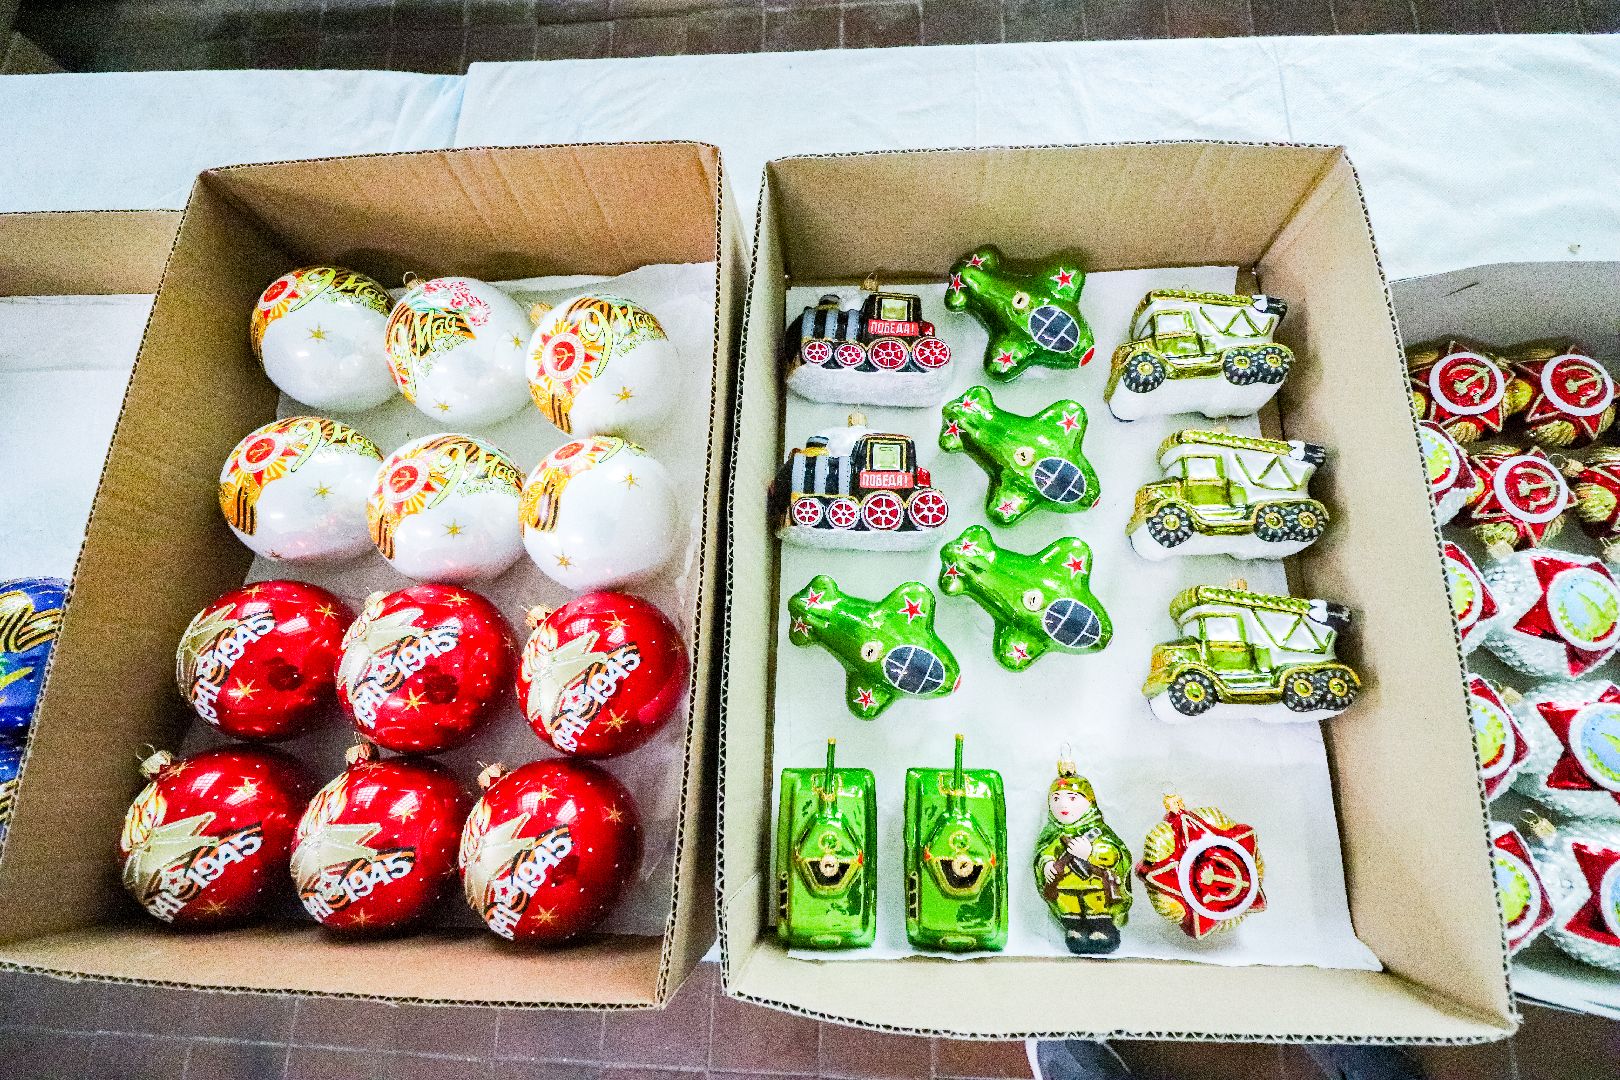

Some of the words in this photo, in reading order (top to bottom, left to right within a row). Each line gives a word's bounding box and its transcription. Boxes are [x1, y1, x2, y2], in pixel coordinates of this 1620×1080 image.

[579, 306, 614, 379] 9
[870, 321, 915, 335] ПОБЕДА!
[428, 443, 467, 510] 9
[862, 473, 908, 488] ПОБЕДА!
[212, 615, 276, 670] 1945
[393, 627, 458, 681] 1945
[583, 647, 641, 706] 1945
[183, 832, 263, 890] 1945
[301, 891, 335, 924] 41
[340, 852, 413, 904] 1945
[512, 828, 572, 898] 1945
